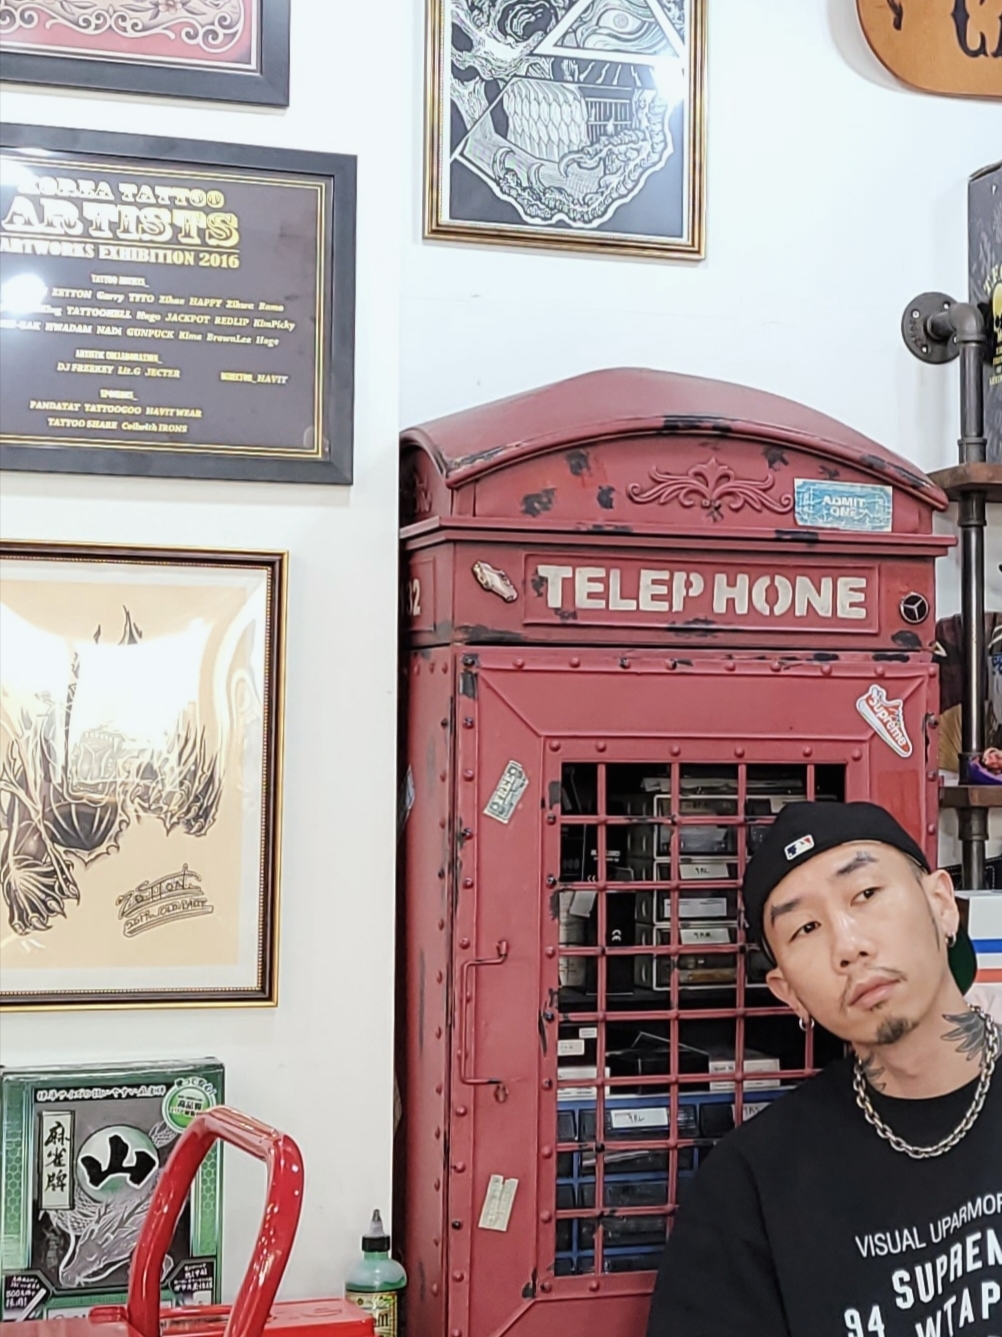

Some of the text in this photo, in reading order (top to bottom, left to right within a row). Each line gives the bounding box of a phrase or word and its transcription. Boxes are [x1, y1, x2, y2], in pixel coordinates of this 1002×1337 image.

[119, 183, 225, 208] TATTOO
[2, 196, 240, 247] ARTISTS
[1, 238, 240, 269] ARTWORKS EXHIBITION 2016
[189, 297, 222, 308] HAPPY
[127, 327, 174, 339] GUNPUCK
[165, 312, 209, 325] JACKPOT
[214, 315, 249, 327] REDLIP
[253, 317, 295, 332] KimPicky
[145, 367, 180, 379] JECTER
[257, 373, 289, 384] HAVIT
[822, 495, 865, 507] ADMIT
[830, 506, 857, 517] ONE
[537, 564, 868, 620] TELEPHONE
[868, 696, 907, 747] Supreme
[45, 1121, 70, 1192] 麻雀牌
[81, 1135, 157, 1188] 山
[855, 1226, 927, 1258] VISUAL
